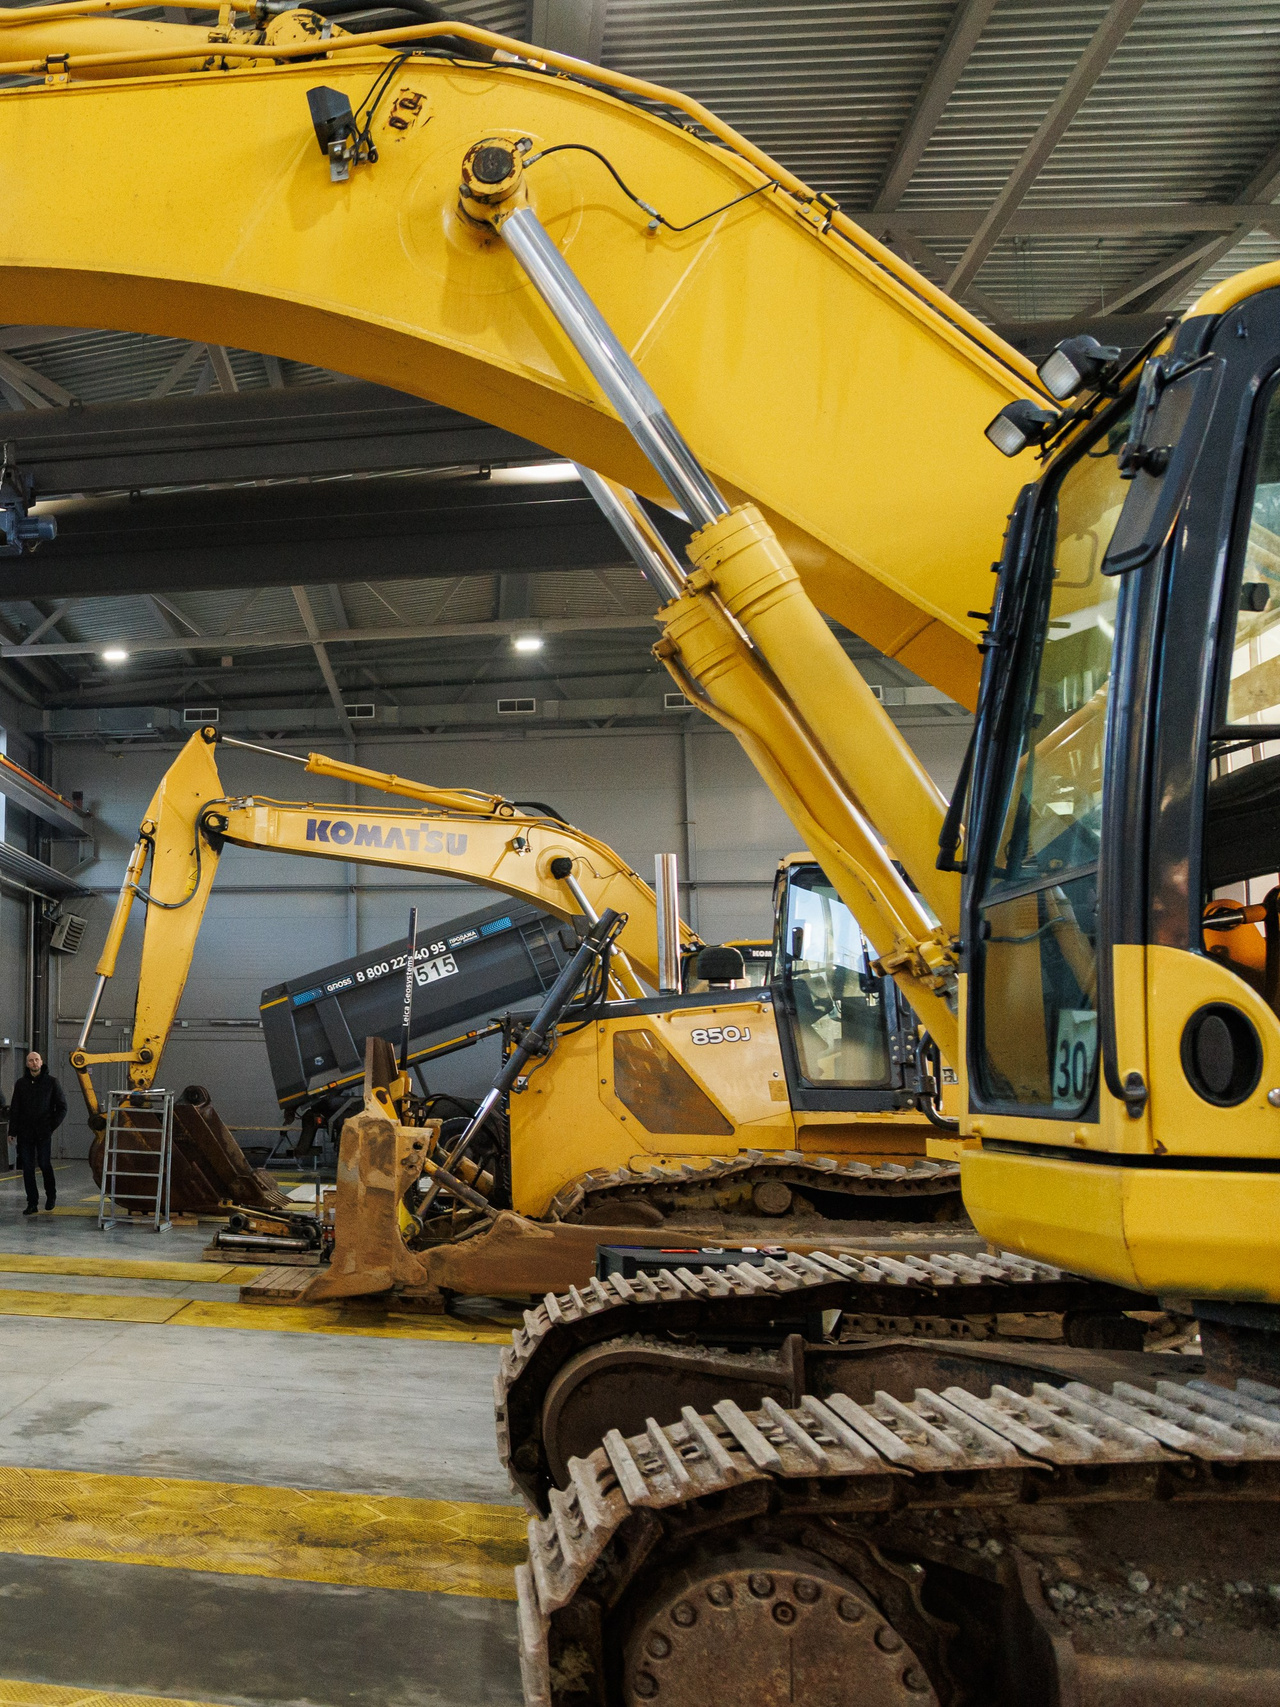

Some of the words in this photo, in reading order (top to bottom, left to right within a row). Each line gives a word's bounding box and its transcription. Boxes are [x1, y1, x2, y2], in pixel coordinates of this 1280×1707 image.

[306, 819, 468, 856] KOMATSU
[356, 972, 365, 982] 8
[366, 962, 389, 978] 800
[414, 948, 429, 960] 40
[430, 941, 446, 955] 95
[416, 956, 456, 982] 515
[327, 978, 352, 992] GROSS
[404, 956, 413, 1004] Geosystems
[402, 1006, 410, 1027] Leica
[691, 1025, 751, 1046] 850J
